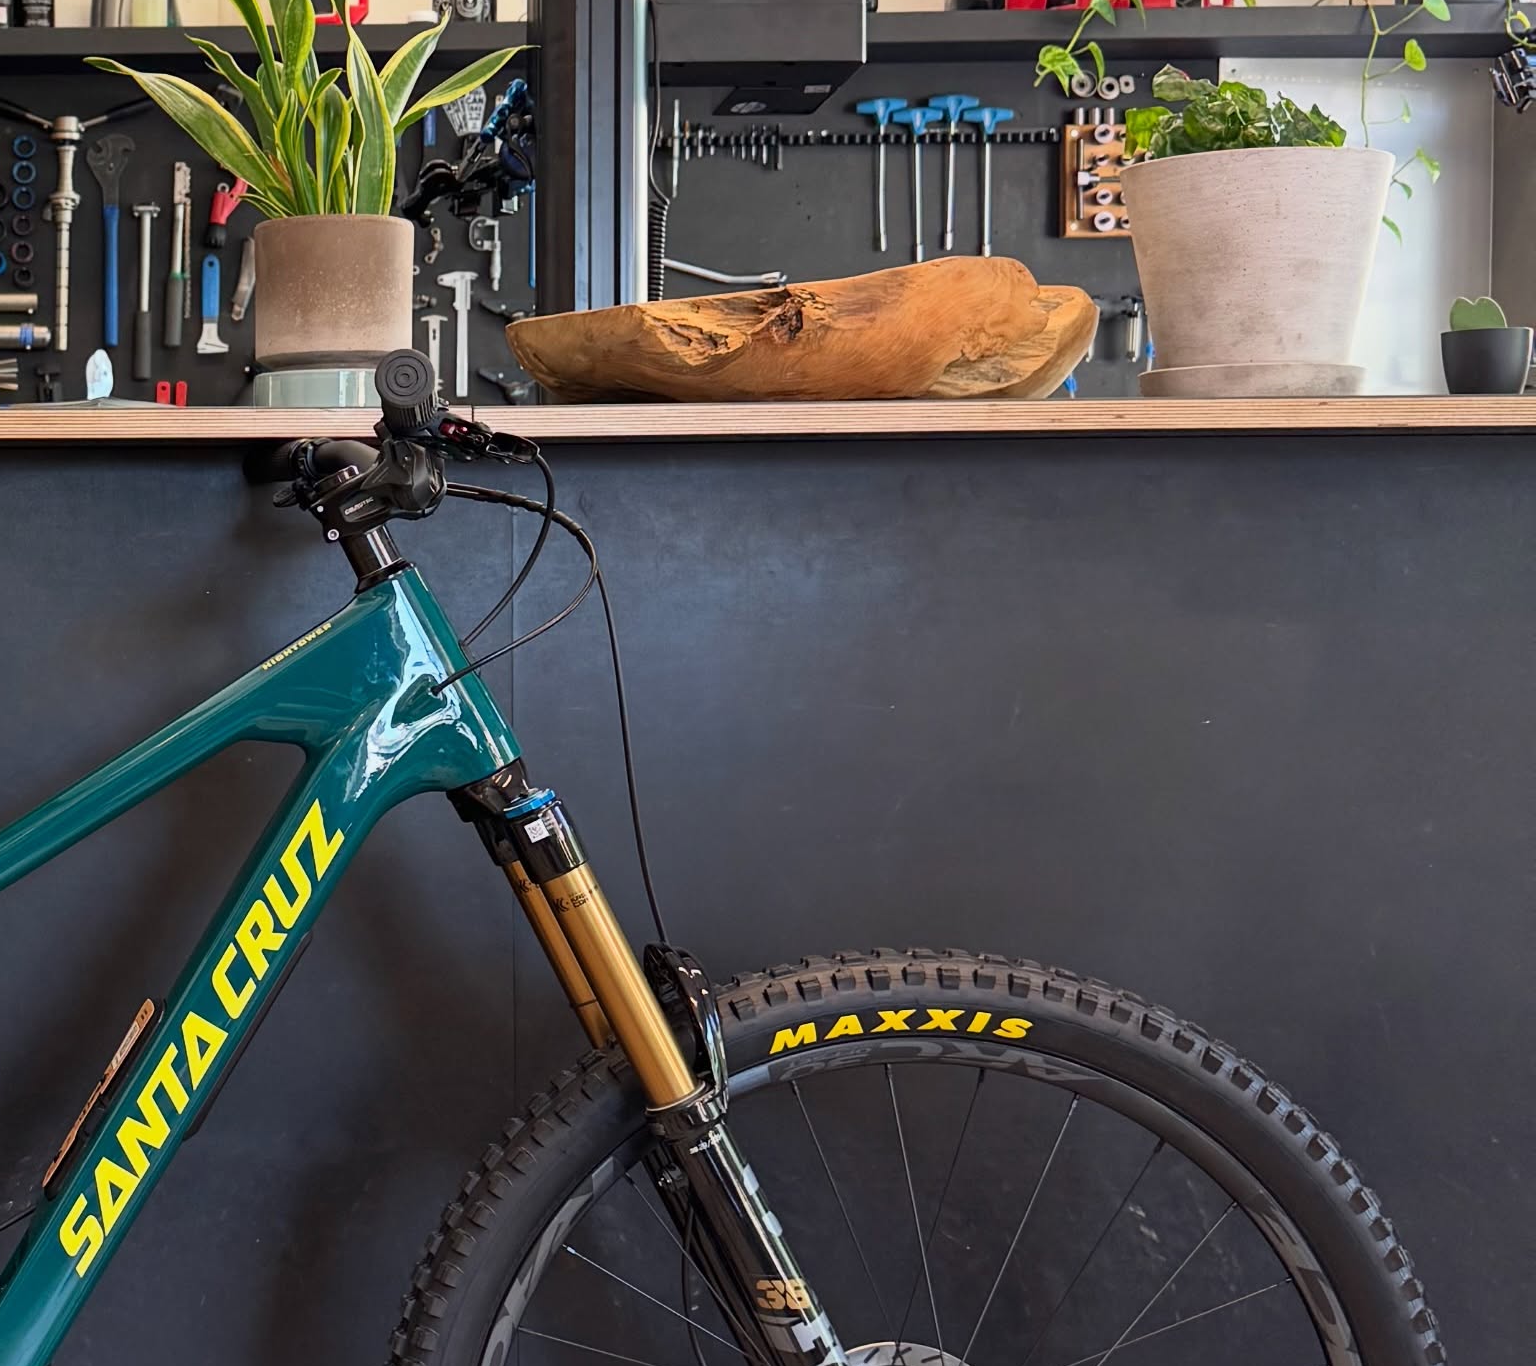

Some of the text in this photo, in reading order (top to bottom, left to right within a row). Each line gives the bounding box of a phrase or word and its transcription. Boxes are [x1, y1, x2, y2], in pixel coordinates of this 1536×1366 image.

[261, 622, 332, 670] HIGHTOWER
[58, 797, 346, 1278] SANTA CRUZ
[769, 1009, 1034, 1055] MAXXIS
[756, 1278, 810, 1310] 36
